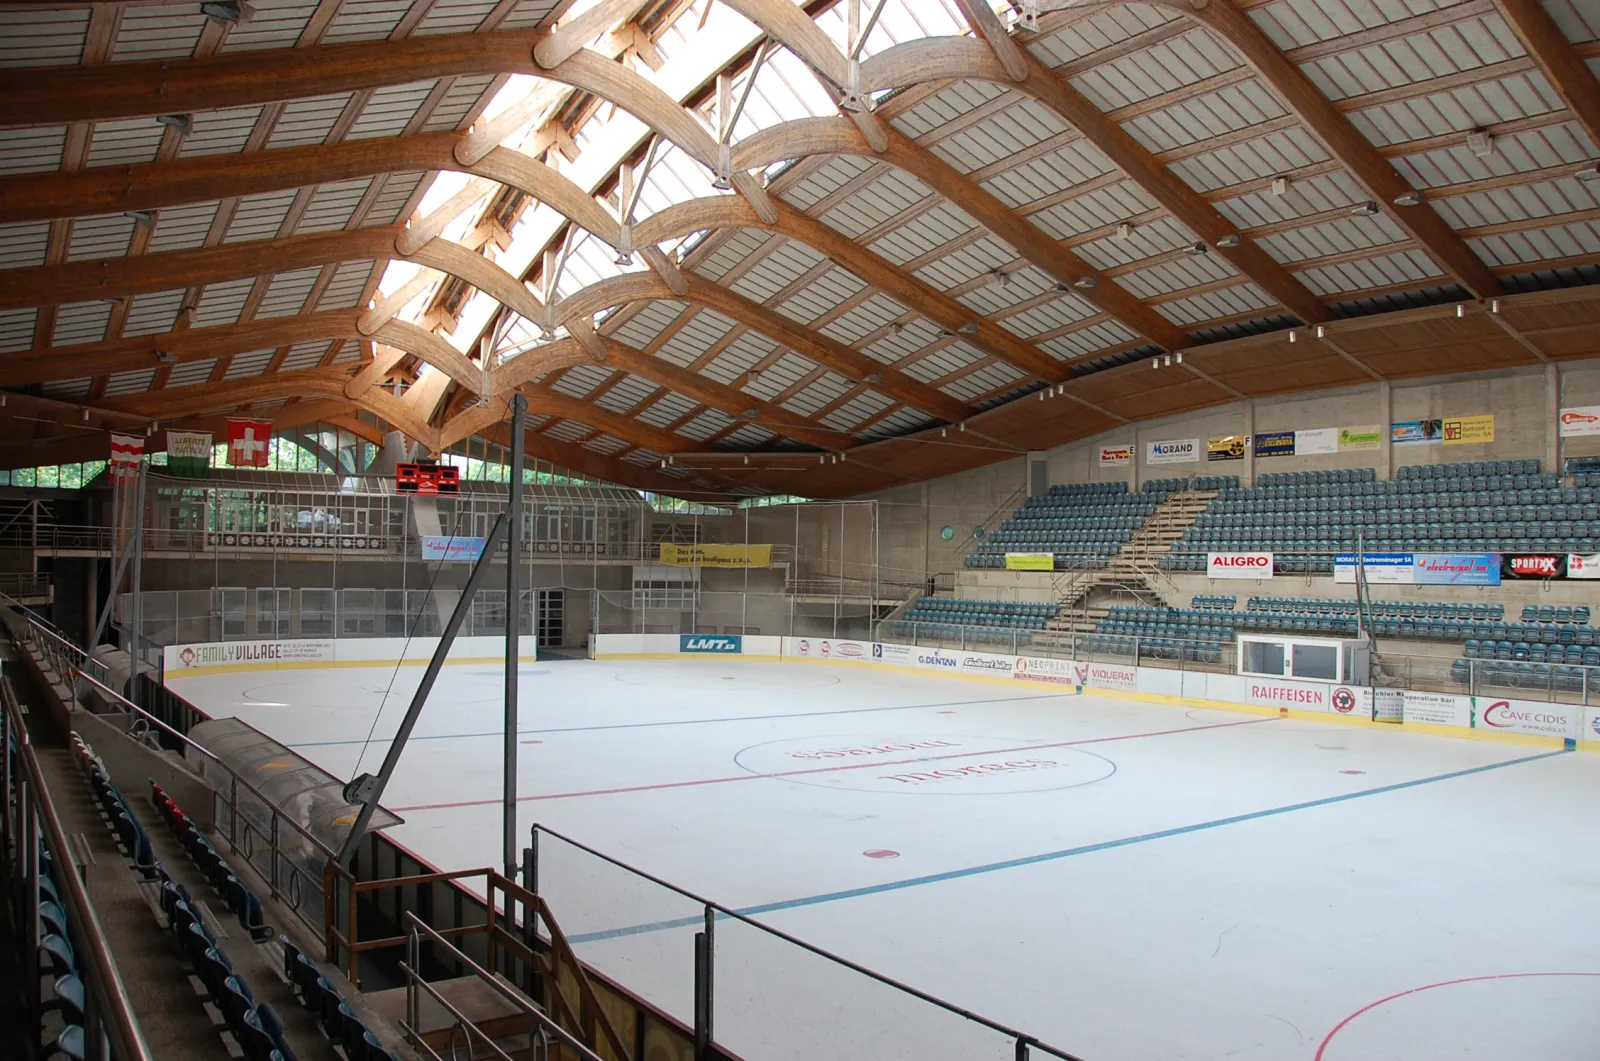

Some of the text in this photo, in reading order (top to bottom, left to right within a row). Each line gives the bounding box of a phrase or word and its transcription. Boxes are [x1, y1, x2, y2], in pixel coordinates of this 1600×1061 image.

[1245, 437, 1251, 446] F
[1129, 446, 1135, 455] E
[1152, 443, 1193, 455] MORAND
[1213, 556, 1269, 567] ALIGRO
[196, 644, 282, 663] FAMILY VILLAGE
[1091, 669, 1135, 681] VIQUERAT
[1251, 685, 1323, 704] RAIFFEISEN
[1500, 710, 1567, 725] CAVE CIDIS
[1521, 723, 1567, 733] www.cidis.ch
